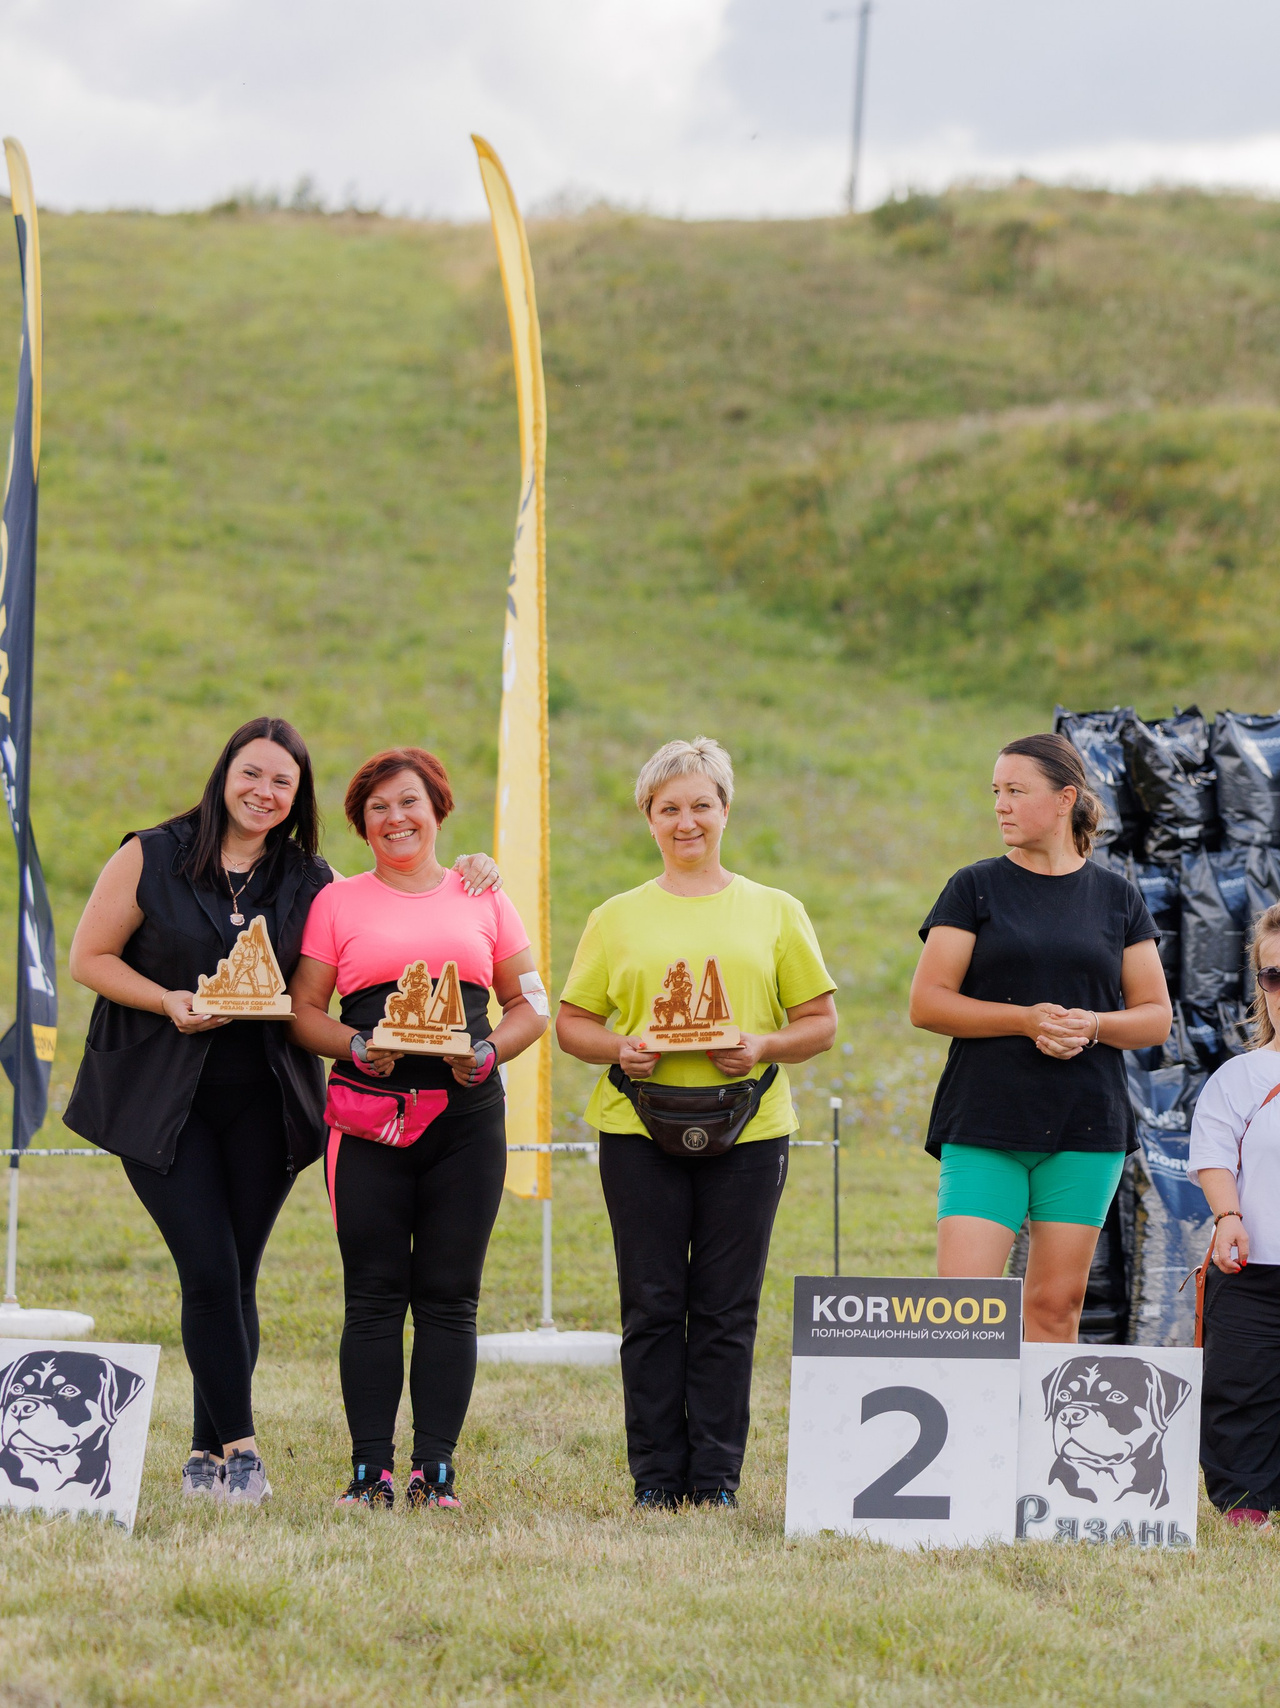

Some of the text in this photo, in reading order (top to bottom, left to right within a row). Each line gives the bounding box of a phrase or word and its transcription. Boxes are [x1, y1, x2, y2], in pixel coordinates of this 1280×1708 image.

[812, 1295, 1007, 1324] KORWOOD
[811, 1328, 1005, 1340] ПОЛНОРАЦИОННЫЙ СУХОЙ КОРМ
[852, 1385, 951, 1519] 2
